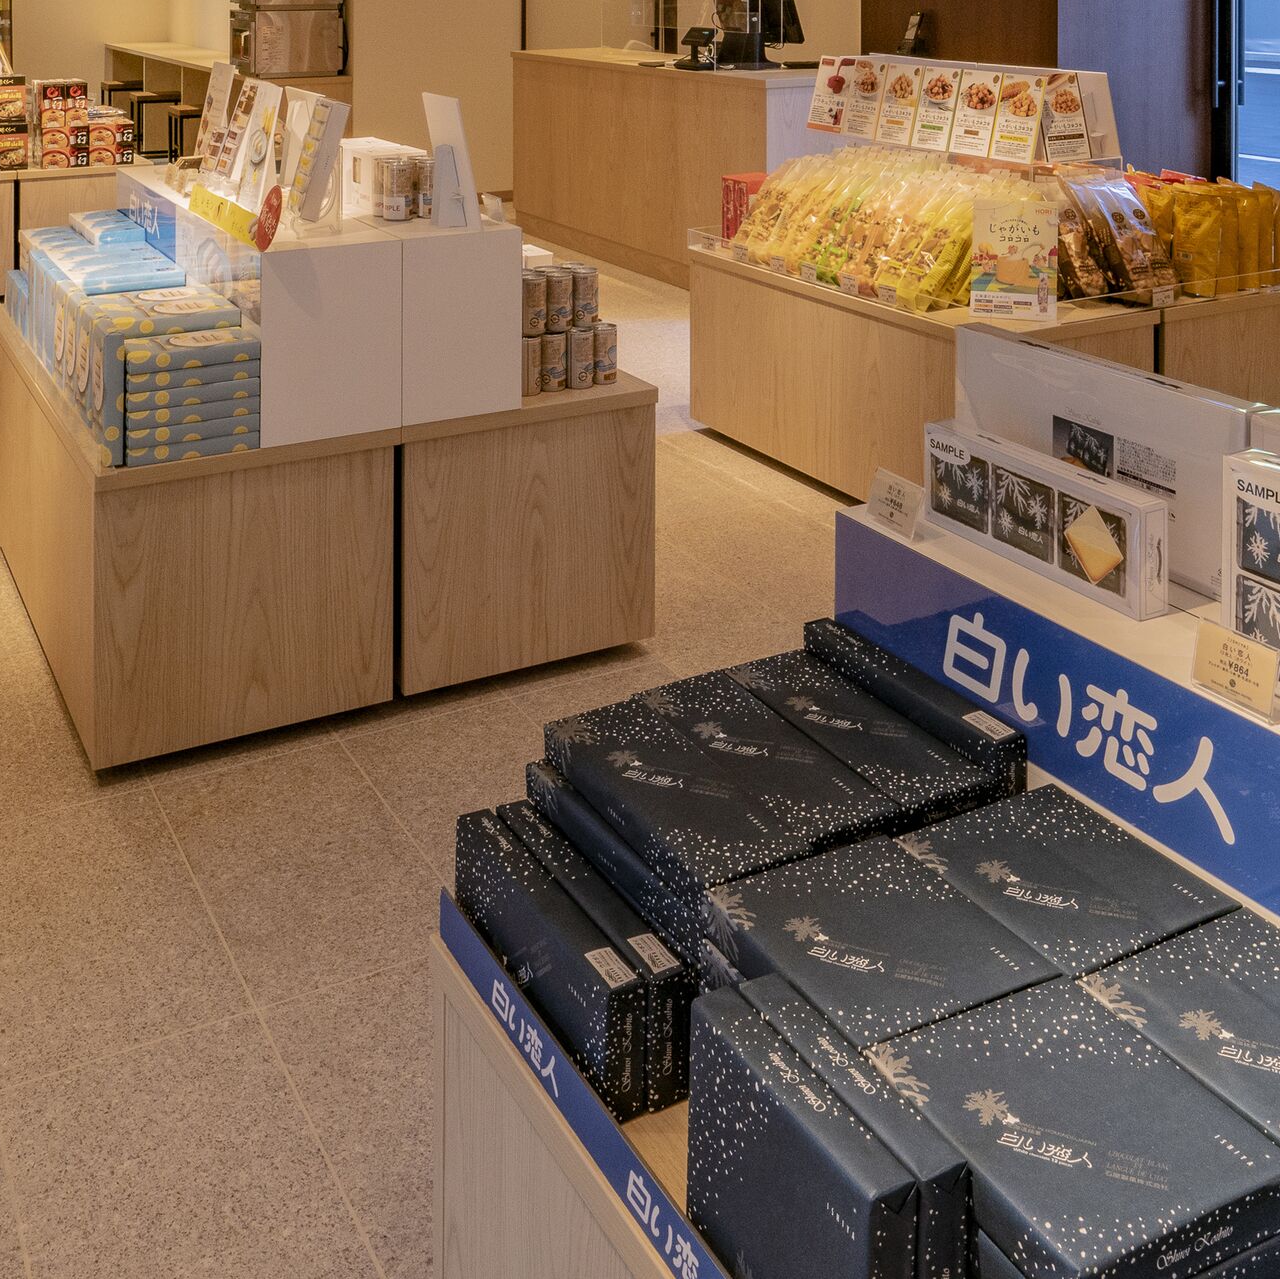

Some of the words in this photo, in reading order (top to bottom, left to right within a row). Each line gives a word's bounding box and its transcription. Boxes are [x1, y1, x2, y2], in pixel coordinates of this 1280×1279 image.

[129, 190, 160, 240] 白い恋人
[989, 223, 1040, 236] じゃがいも
[999, 235, 1030, 243] コロコロ
[930, 438, 965, 460] SAMPLE
[1228, 660, 1249, 677] ¥864
[943, 612, 1236, 846] 白い恋人
[491, 978, 560, 1098] 白い恋人
[997, 1131, 1093, 1168] 白い恋人
[1214, 1134, 1255, 1167] ISHIYA
